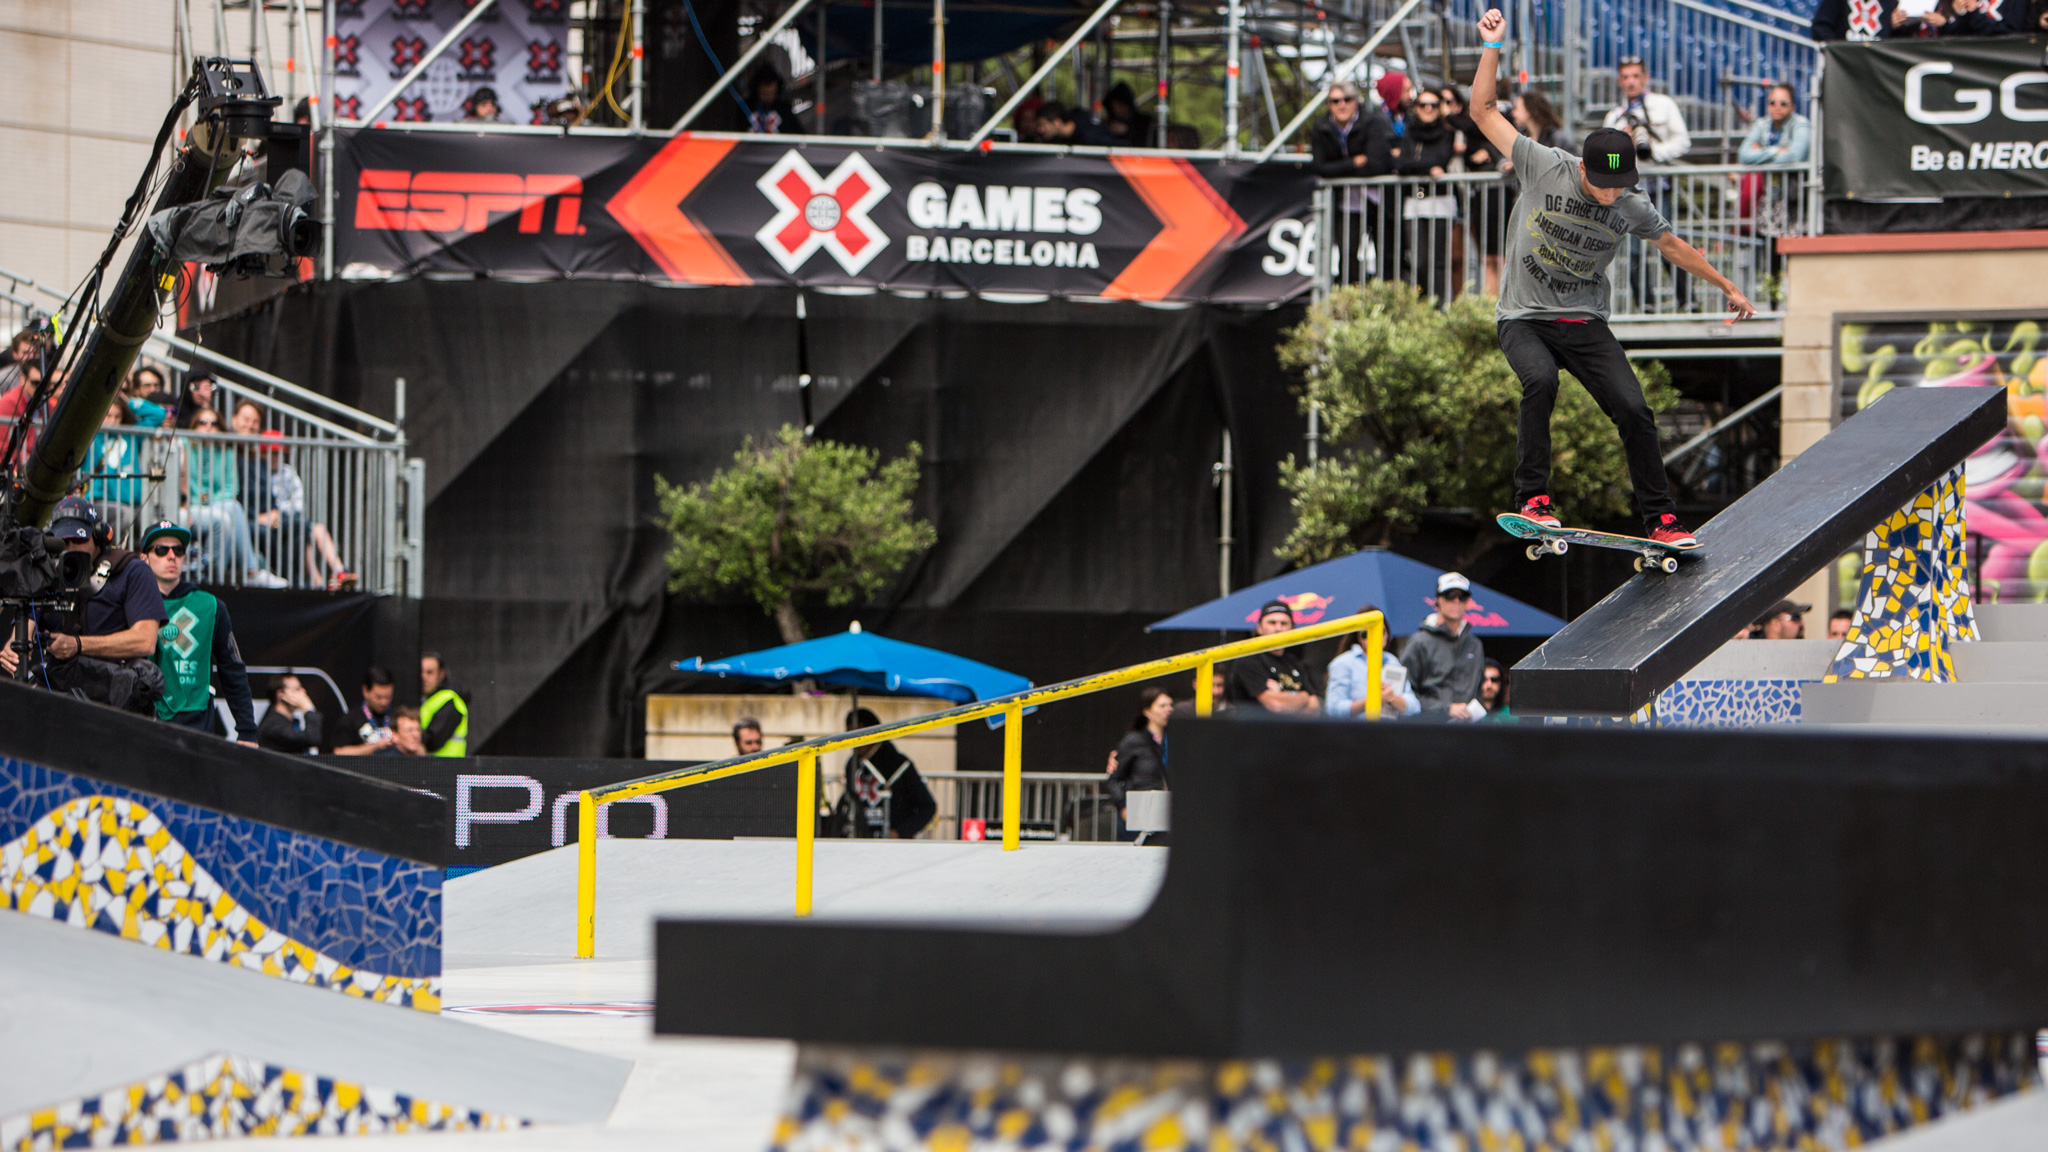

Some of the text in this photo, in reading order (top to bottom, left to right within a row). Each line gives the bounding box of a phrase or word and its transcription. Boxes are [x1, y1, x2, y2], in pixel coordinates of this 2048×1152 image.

[1911, 140, 2048, 171] Be a HERO
[355, 169, 587, 235] ESPN
[907, 182, 1102, 235] GAMES
[1546, 193, 1562, 212] DC
[1565, 198, 1593, 219] SHOE
[1535, 211, 1583, 246] AMERICAN
[906, 235, 1100, 269] BARCELONA
[1523, 254, 1549, 284] SINCE
